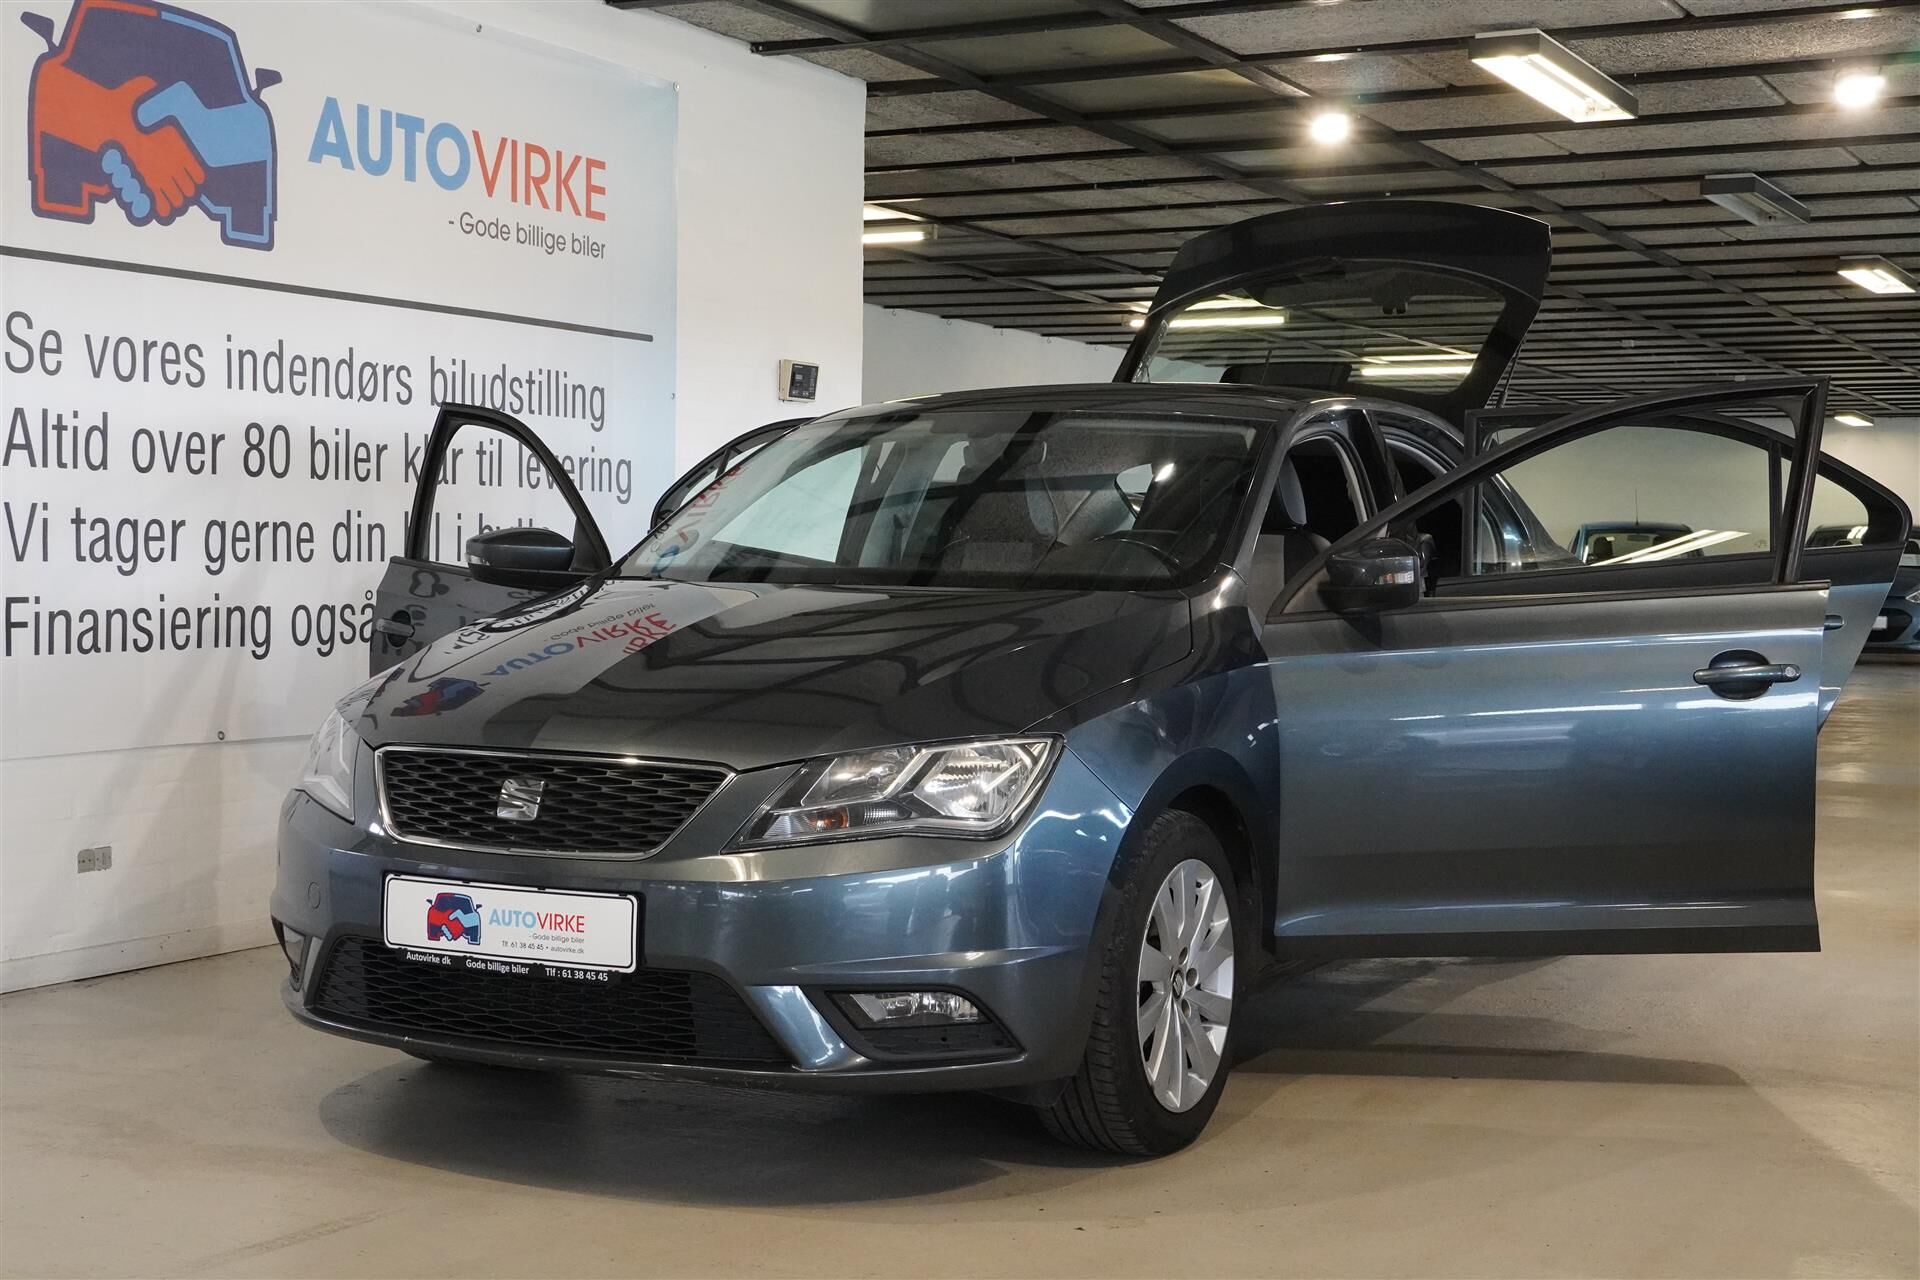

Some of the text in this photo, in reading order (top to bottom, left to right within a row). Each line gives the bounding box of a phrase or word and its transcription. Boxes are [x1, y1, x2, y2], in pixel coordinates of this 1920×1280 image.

[308, 96, 607, 222] AUTOVIRKE
[459, 211, 511, 242] Gode
[516, 221, 567, 256] billige
[571, 232, 606, 260] biler
[4, 310, 606, 433] Se vores indendørs biludstilling
[2, 406, 109, 472] Altid
[131, 427, 226, 477] over
[242, 421, 292, 480] 80
[309, 425, 389, 484] biler
[475, 437, 503, 488] til
[3, 501, 49, 562] Vi
[70, 506, 187, 577] tager
[204, 519, 315, 577] gerne
[332, 509, 387, 564] din
[4, 592, 273, 661] Finansiering
[291, 588, 376, 658] også
[489, 908, 585, 933] AUTOVIRKE
[532, 933, 550, 941] Gode
[551, 936, 570, 944] billige
[465, 959, 486, 969] Gode
[487, 961, 510, 974] billige
[511, 964, 529, 974] biler
[545, 967, 556, 977] Tlf
[562, 969, 572, 979] 61
[573, 970, 585, 980] 38
[585, 971, 597, 981] 45
[597, 972, 609, 982] 45
